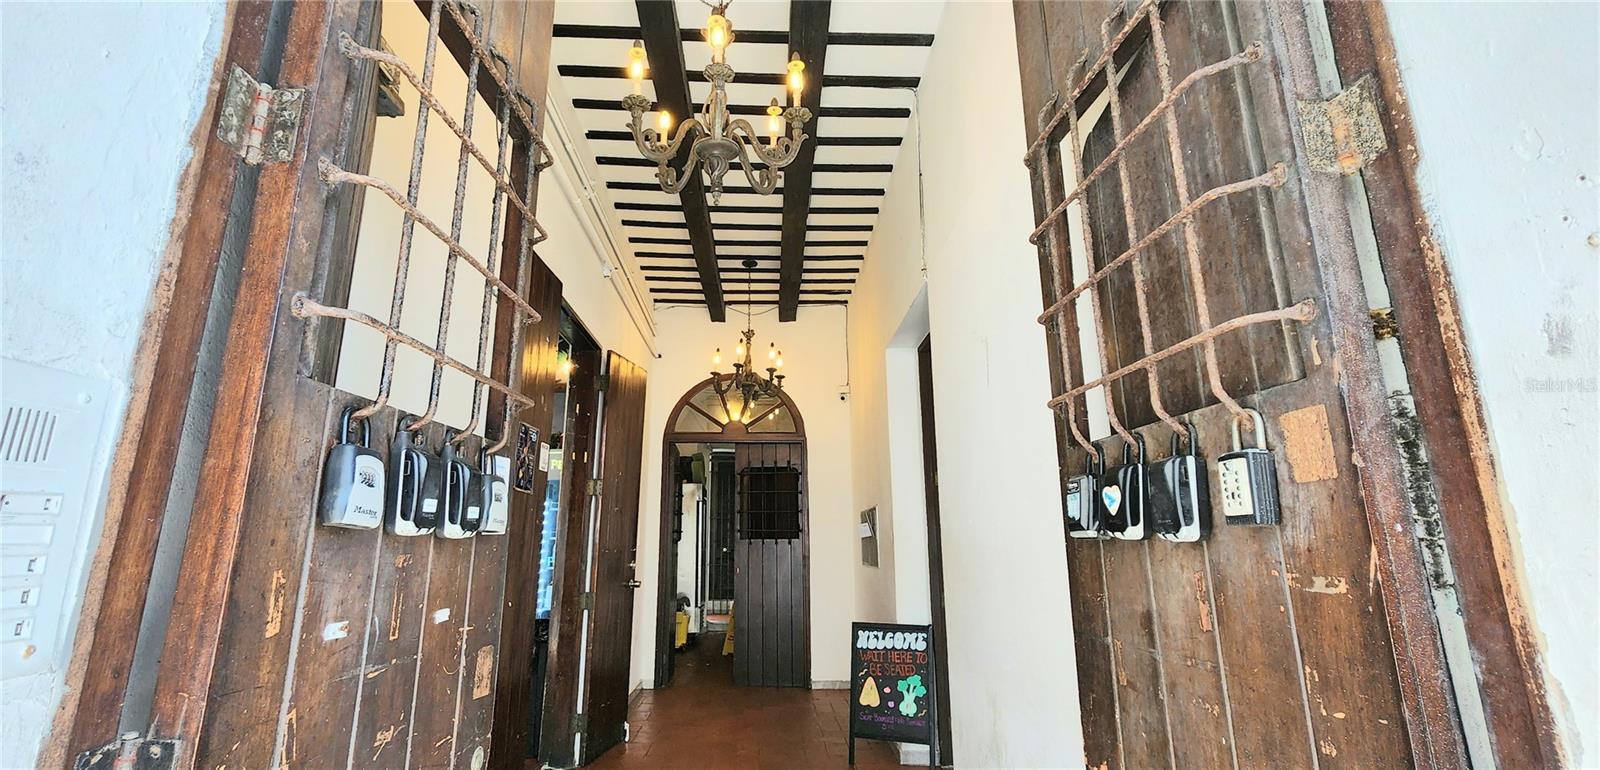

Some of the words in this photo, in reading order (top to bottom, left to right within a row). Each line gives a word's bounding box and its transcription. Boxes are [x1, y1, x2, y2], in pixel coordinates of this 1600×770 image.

[353, 505, 378, 516] Master
[856, 630, 928, 651] WELCOME
[859, 650, 886, 662] WAIT
[888, 650, 913, 663] HERE
[915, 652, 928, 664] TO
[869, 663, 882, 676] BE
[884, 663, 916, 676] SEATED
